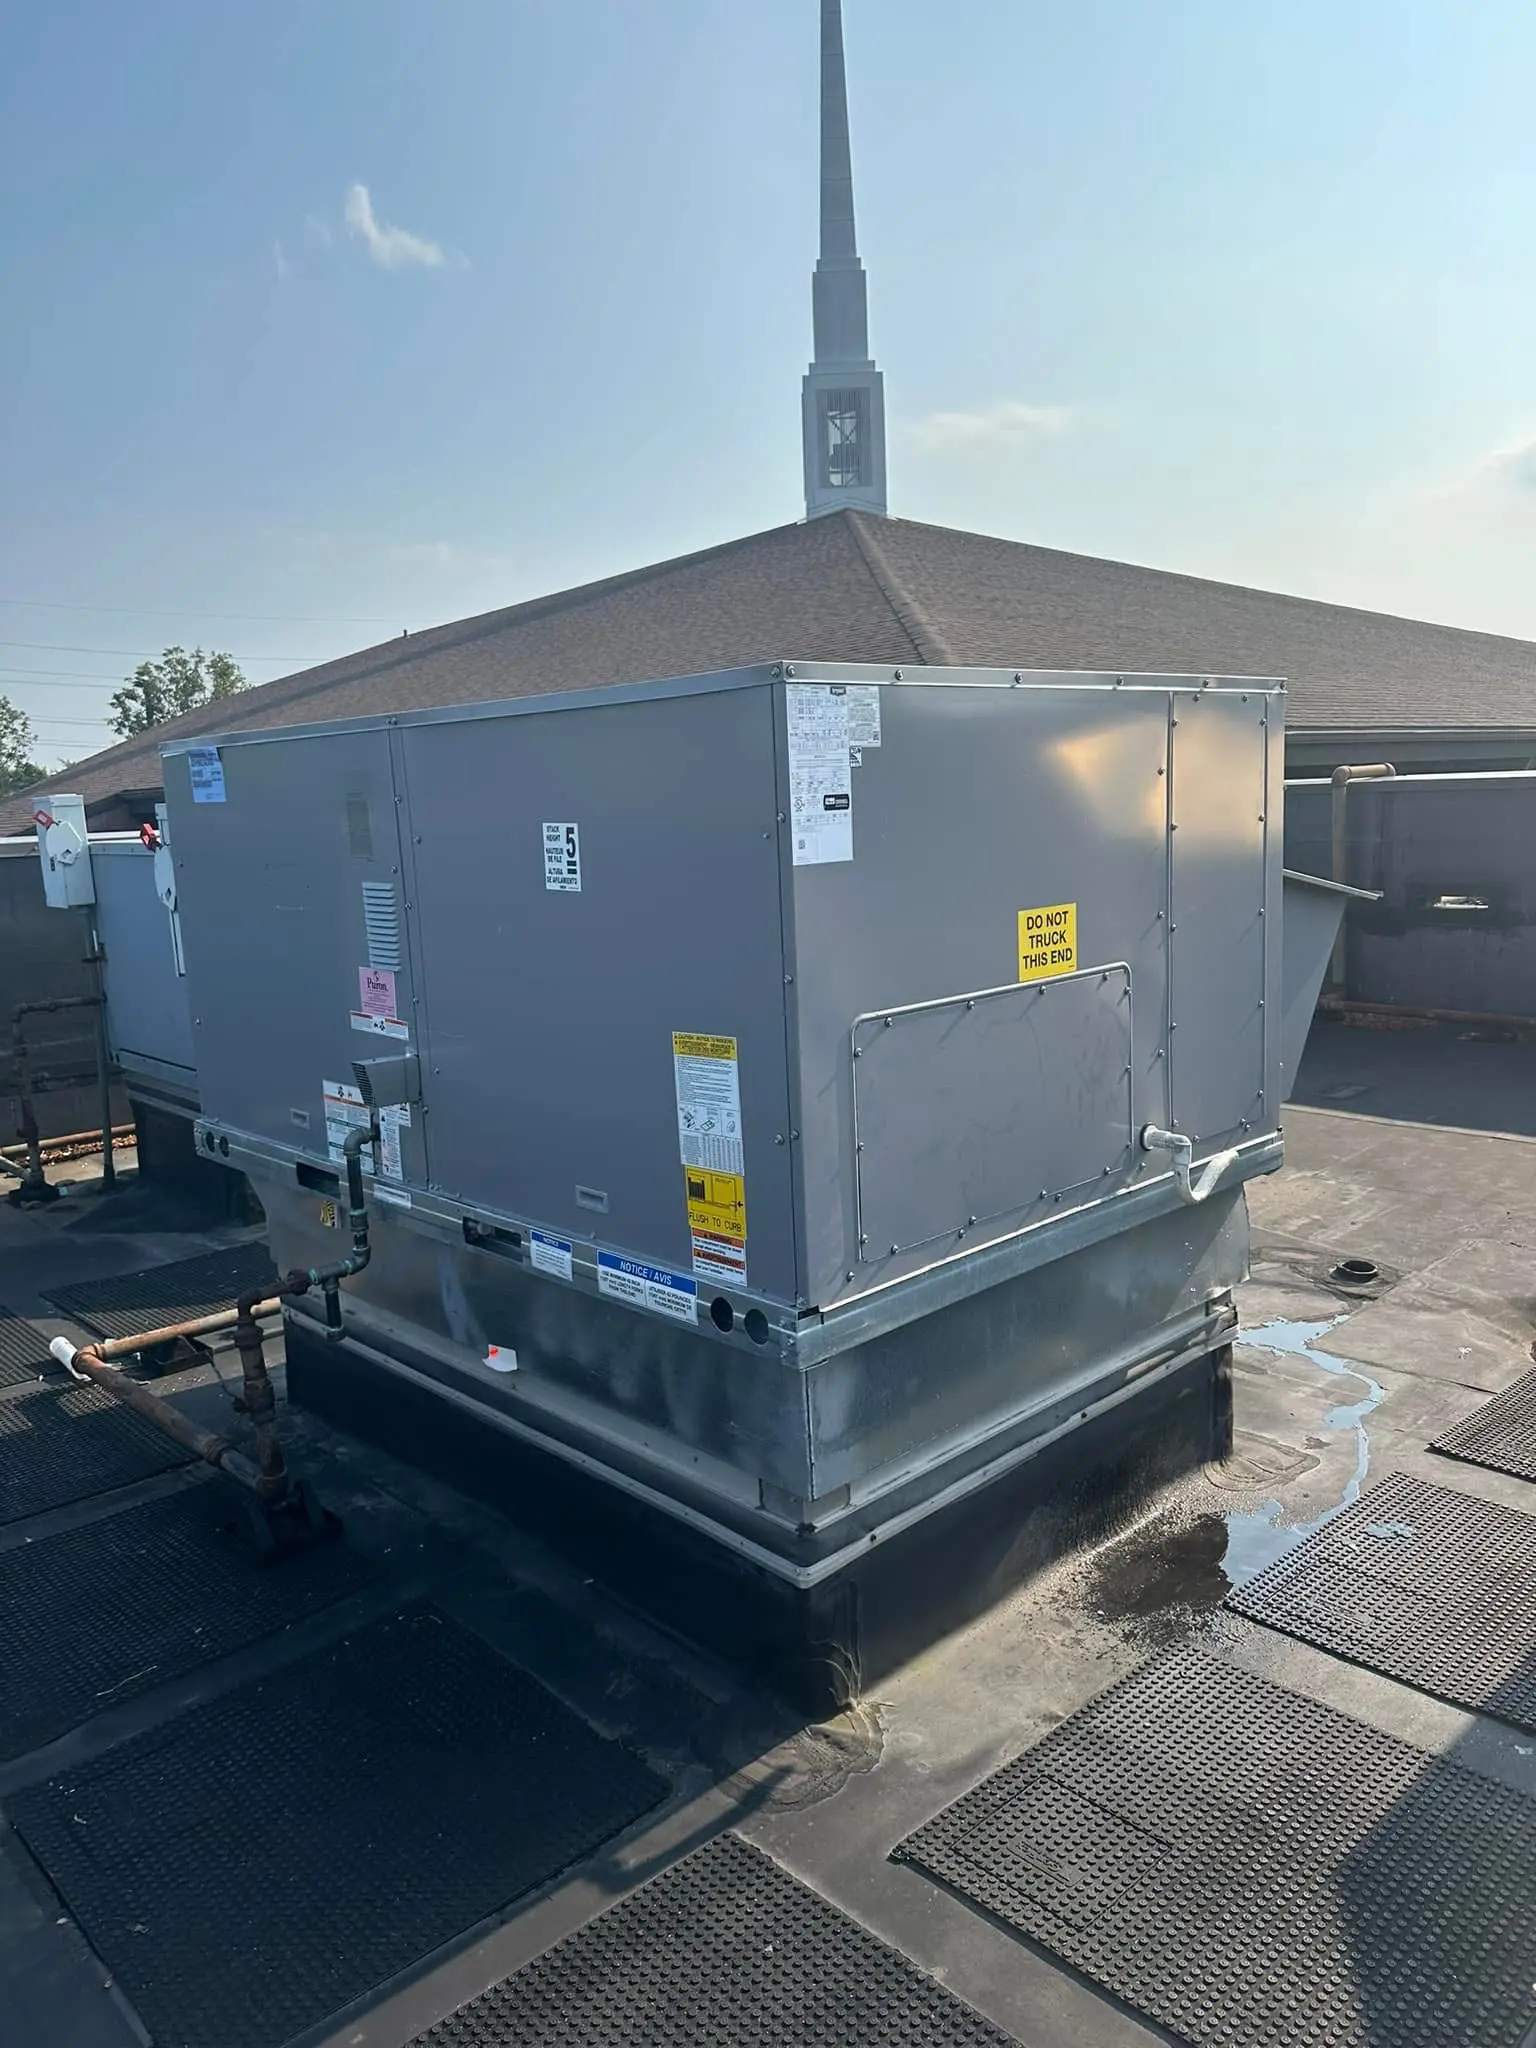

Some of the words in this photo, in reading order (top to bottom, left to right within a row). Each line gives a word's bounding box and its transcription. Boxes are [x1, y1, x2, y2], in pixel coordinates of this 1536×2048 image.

[566, 827, 576, 858] 5
[1026, 914, 1043, 930] DO
[1046, 911, 1069, 927] NOT
[1028, 930, 1067, 949] TRUCK
[1022, 952, 1048, 970] THIS
[1051, 947, 1073, 964] END
[688, 1211, 709, 1224] FLUSH
[712, 1217, 721, 1227] TO
[724, 1220, 742, 1233] CURB
[620, 1260, 648, 1278] NOTICE
[654, 1271, 672, 1286] AVIS
